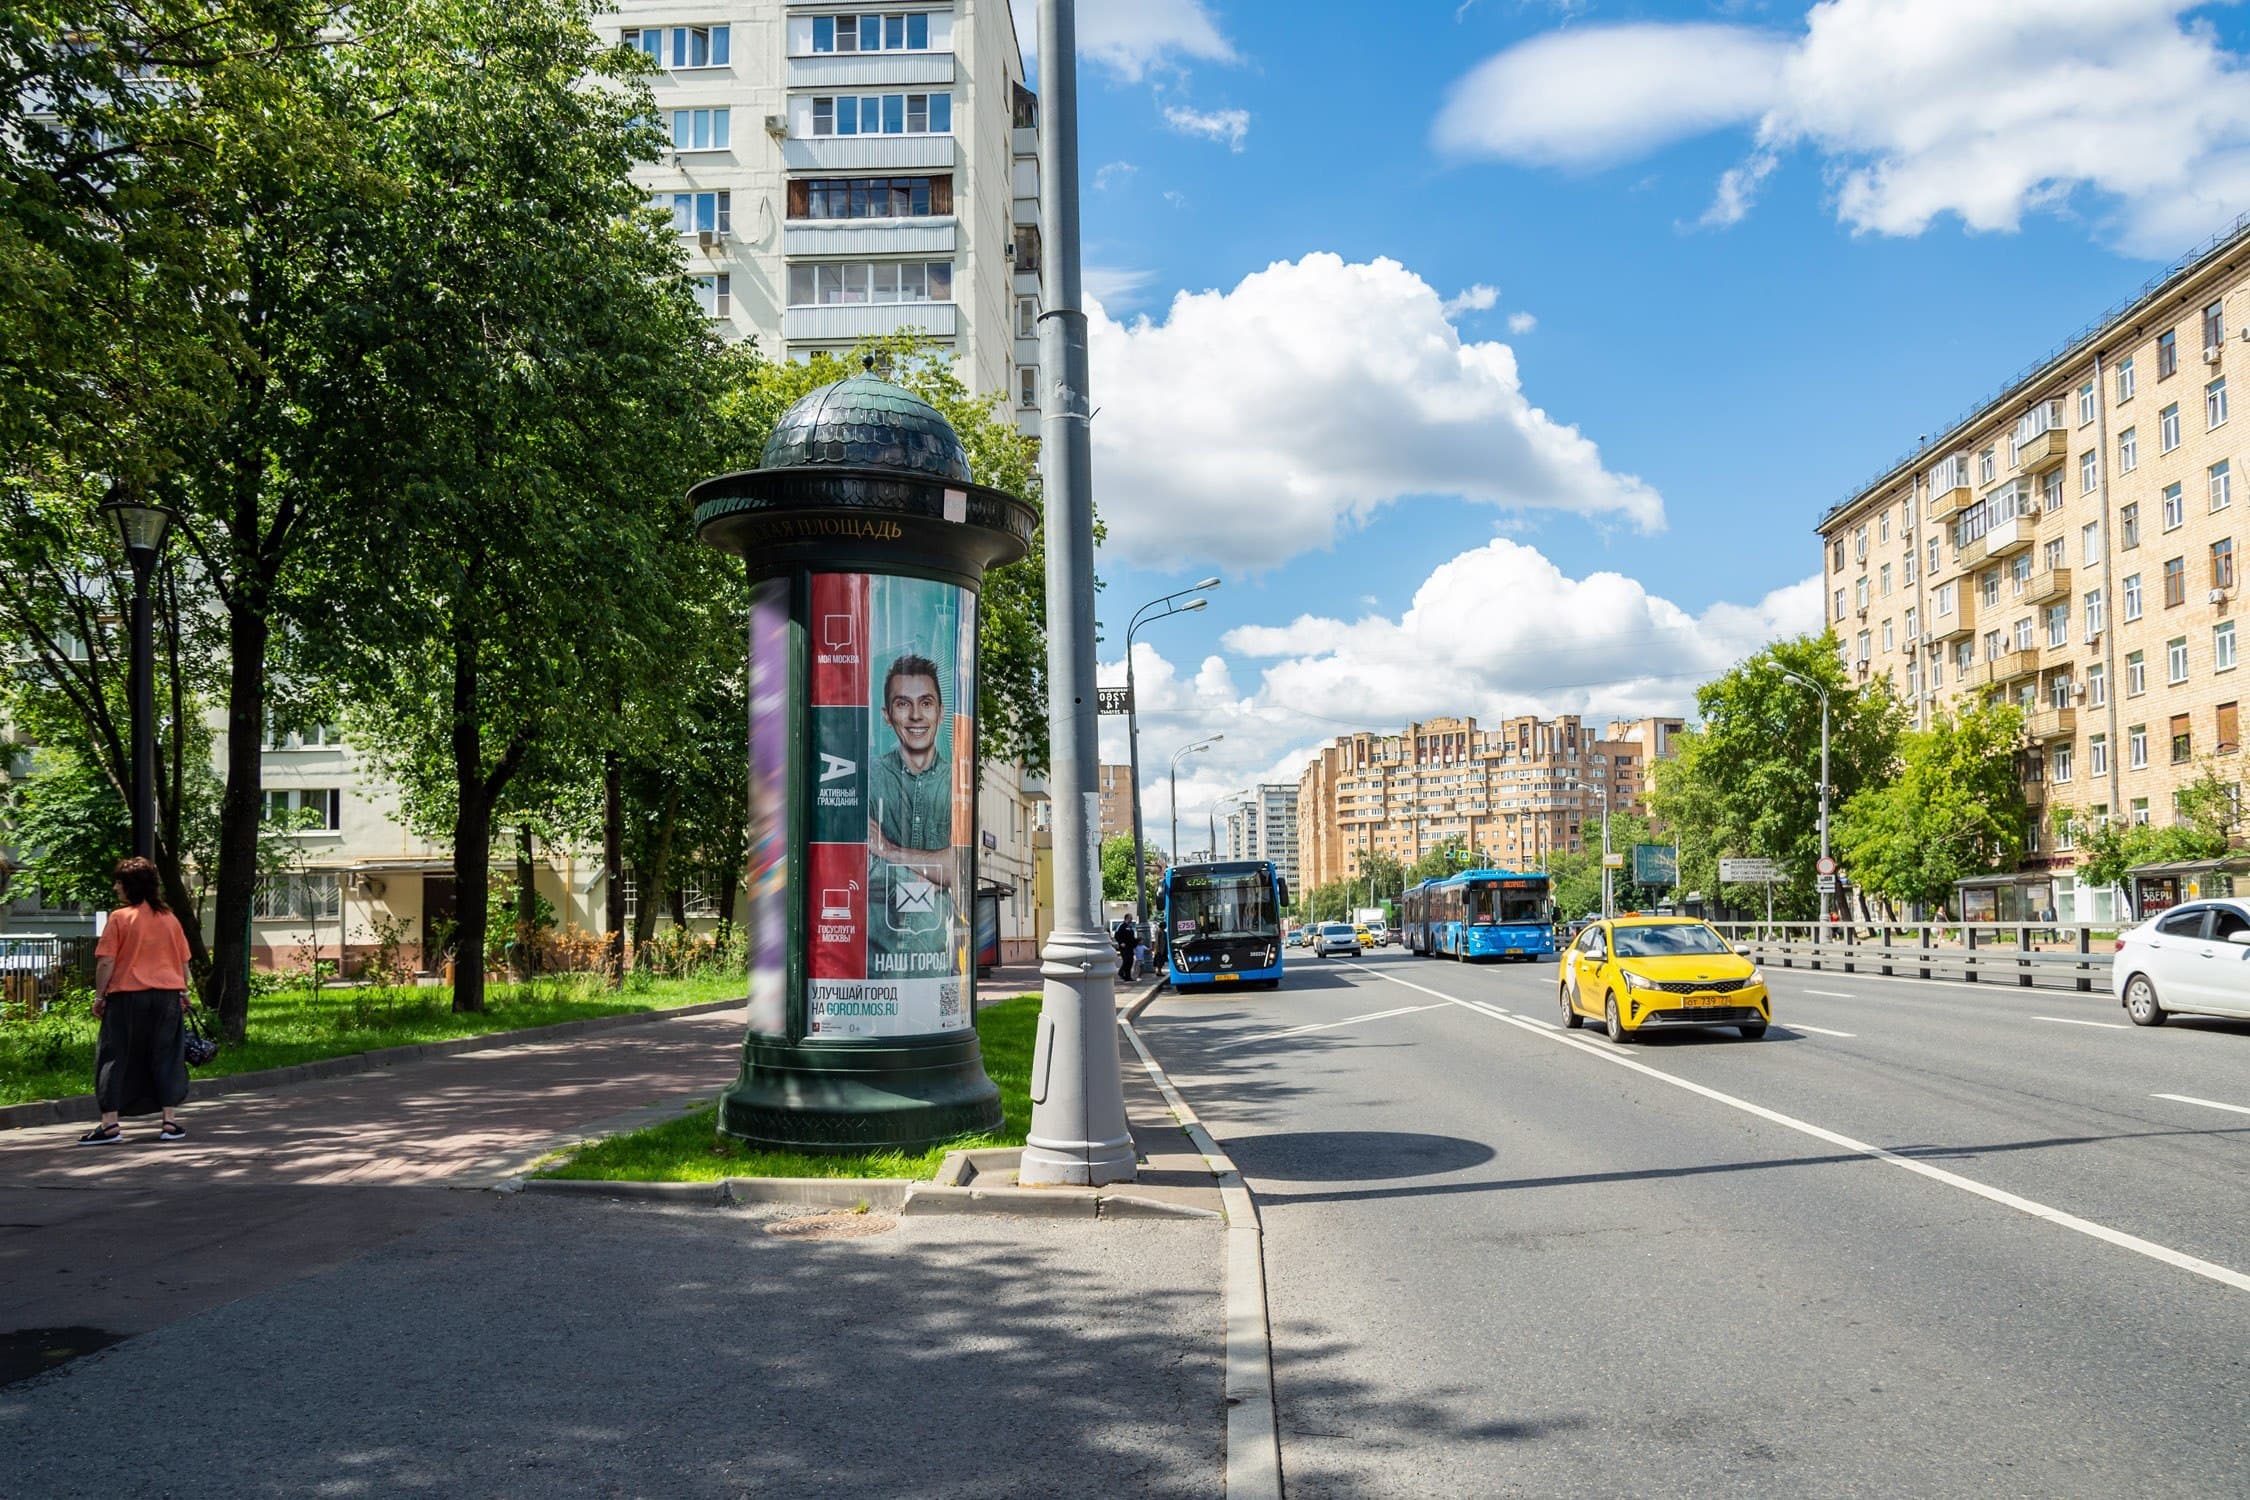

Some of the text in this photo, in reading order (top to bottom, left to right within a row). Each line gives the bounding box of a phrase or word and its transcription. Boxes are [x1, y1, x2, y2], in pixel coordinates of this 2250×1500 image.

[794, 518, 903, 541] ПЛОЩАДЬ
[818, 654, 860, 664] МОЯ МОСКВА
[819, 787, 856, 798] АКТИВНЫЙ
[817, 797, 859, 807] ГРАЖДАНИН
[818, 925, 856, 935] ГОСУСЛУГИ
[822, 934, 851, 943] МОСКВЫ
[875, 952, 948, 972] НАШ ГОРОД
[811, 985, 898, 1001] УЛУЧШАЙ ГОРОД
[811, 1002, 899, 1016] НА GOROD.MOS.RU
